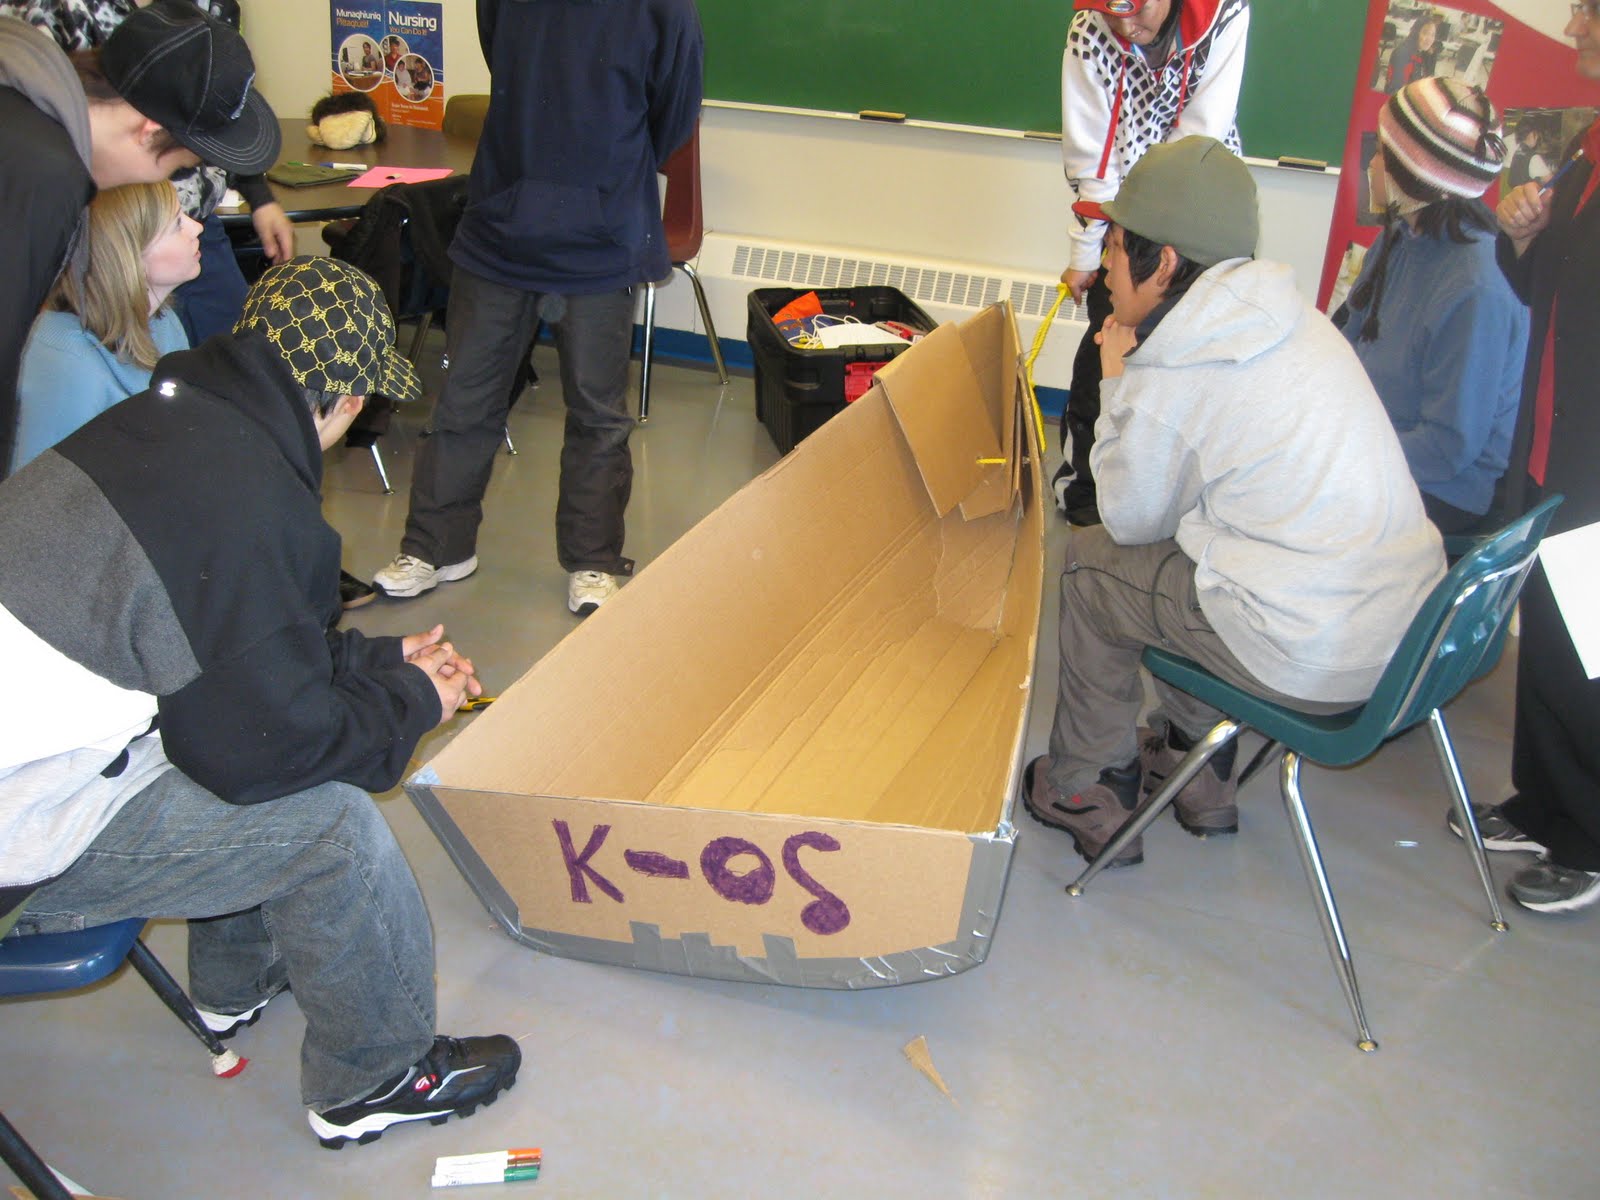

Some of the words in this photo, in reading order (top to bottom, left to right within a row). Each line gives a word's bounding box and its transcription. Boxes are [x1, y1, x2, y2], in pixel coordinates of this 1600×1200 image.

[388, 11, 437, 31] Nursing
[400, 26, 412, 35] Can
[412, 27, 422, 35] Do
